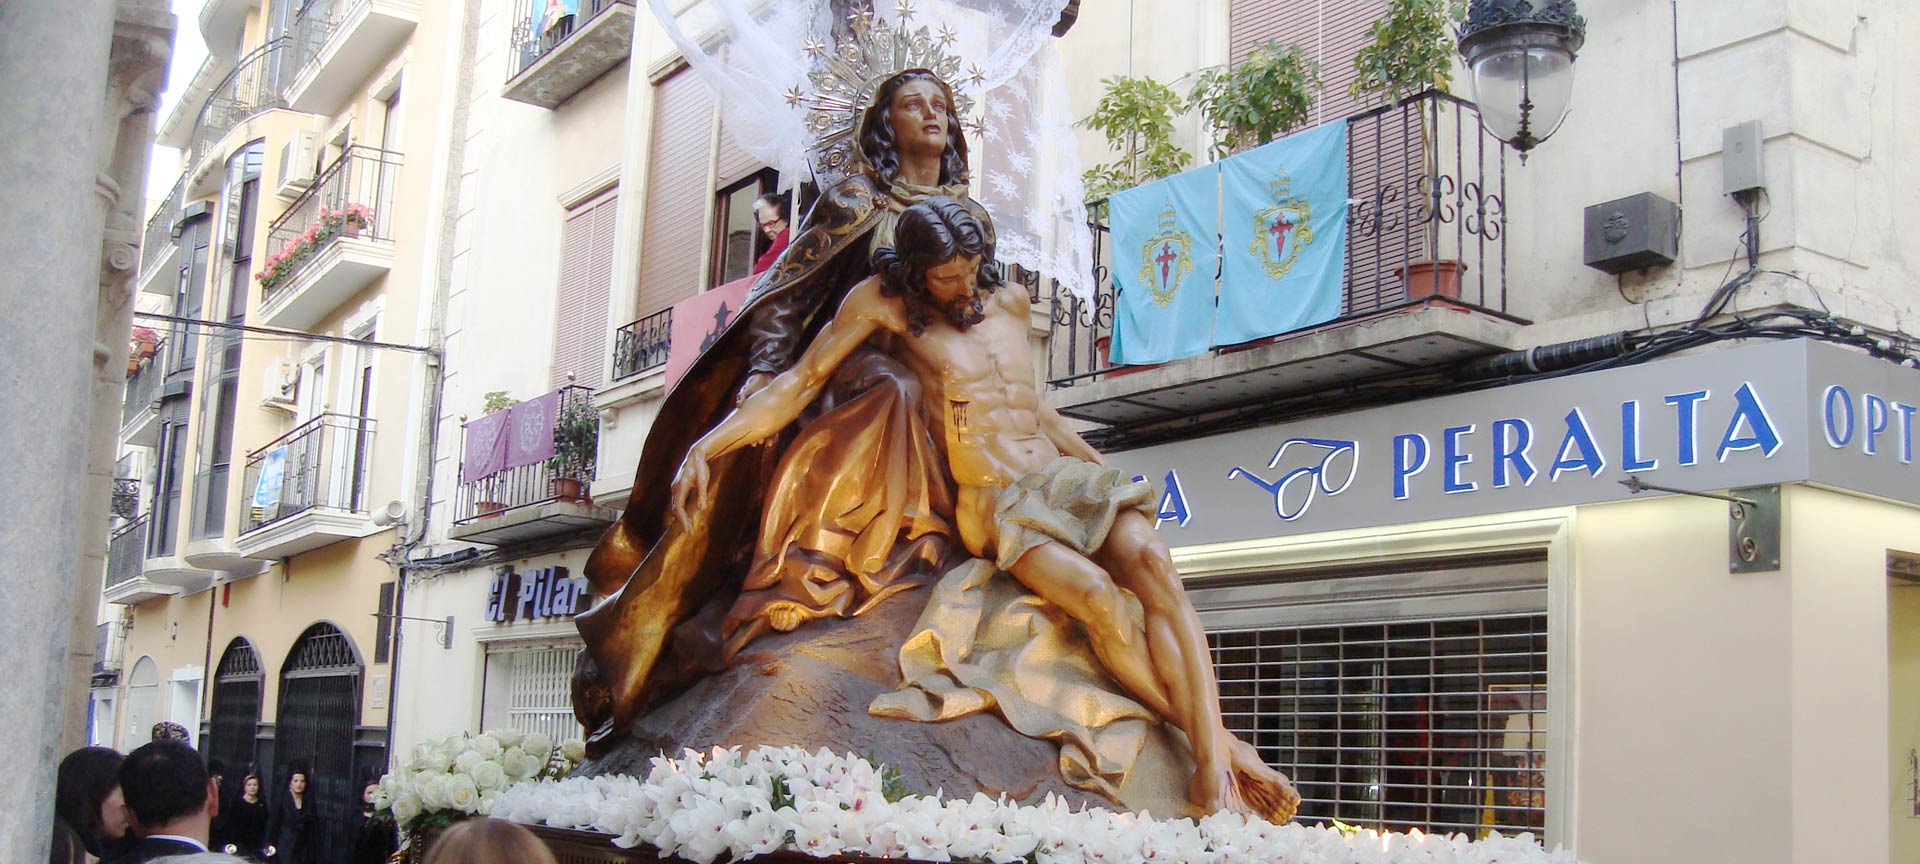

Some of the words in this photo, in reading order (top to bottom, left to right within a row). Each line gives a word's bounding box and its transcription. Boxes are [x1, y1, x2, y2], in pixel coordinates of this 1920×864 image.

[1131, 469, 1191, 530] A
[1393, 381, 1783, 500] PERALTA
[516, 566, 589, 620] Pilar
